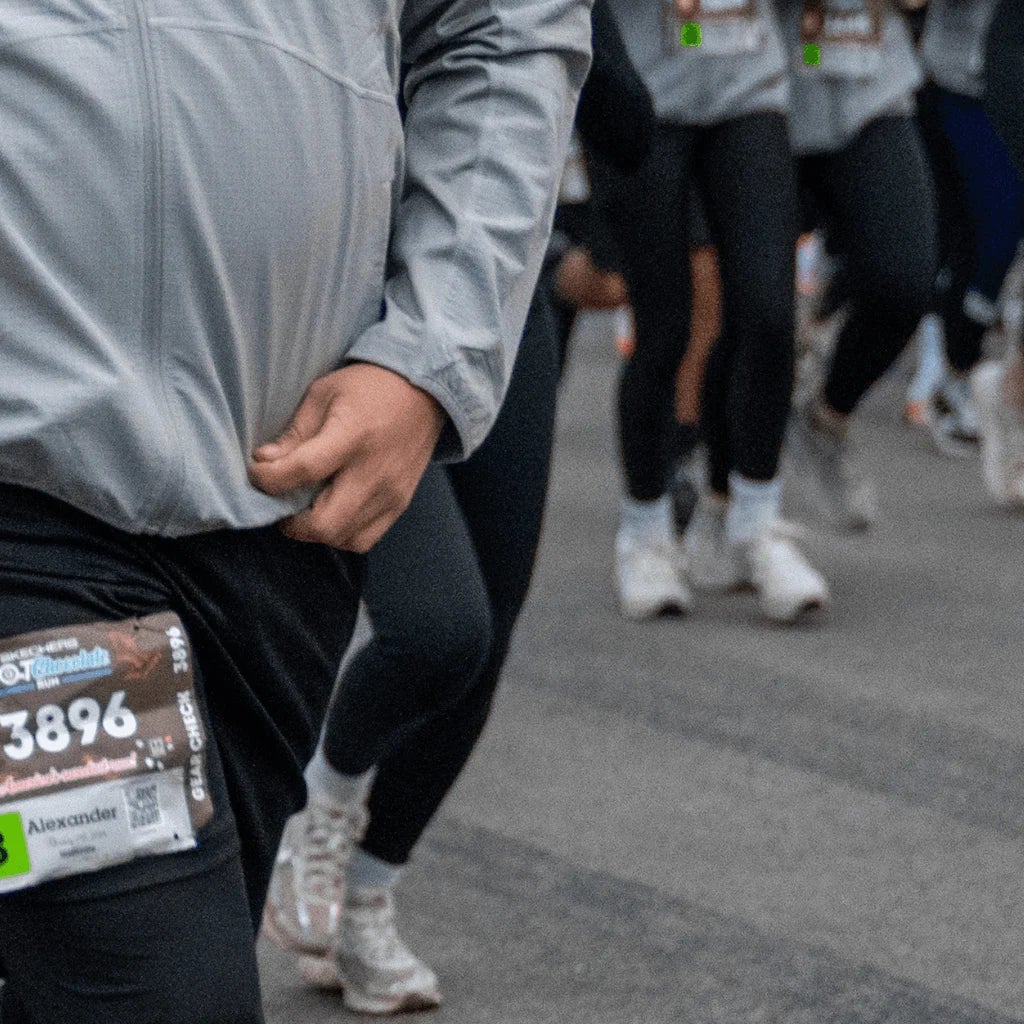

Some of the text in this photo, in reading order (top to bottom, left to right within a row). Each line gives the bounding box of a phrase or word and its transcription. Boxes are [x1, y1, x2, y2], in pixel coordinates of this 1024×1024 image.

[165, 626, 189, 674] 3896
[177, 690, 206, 802] GEAR CHECK
[28, 806, 117, 835] Alexander
